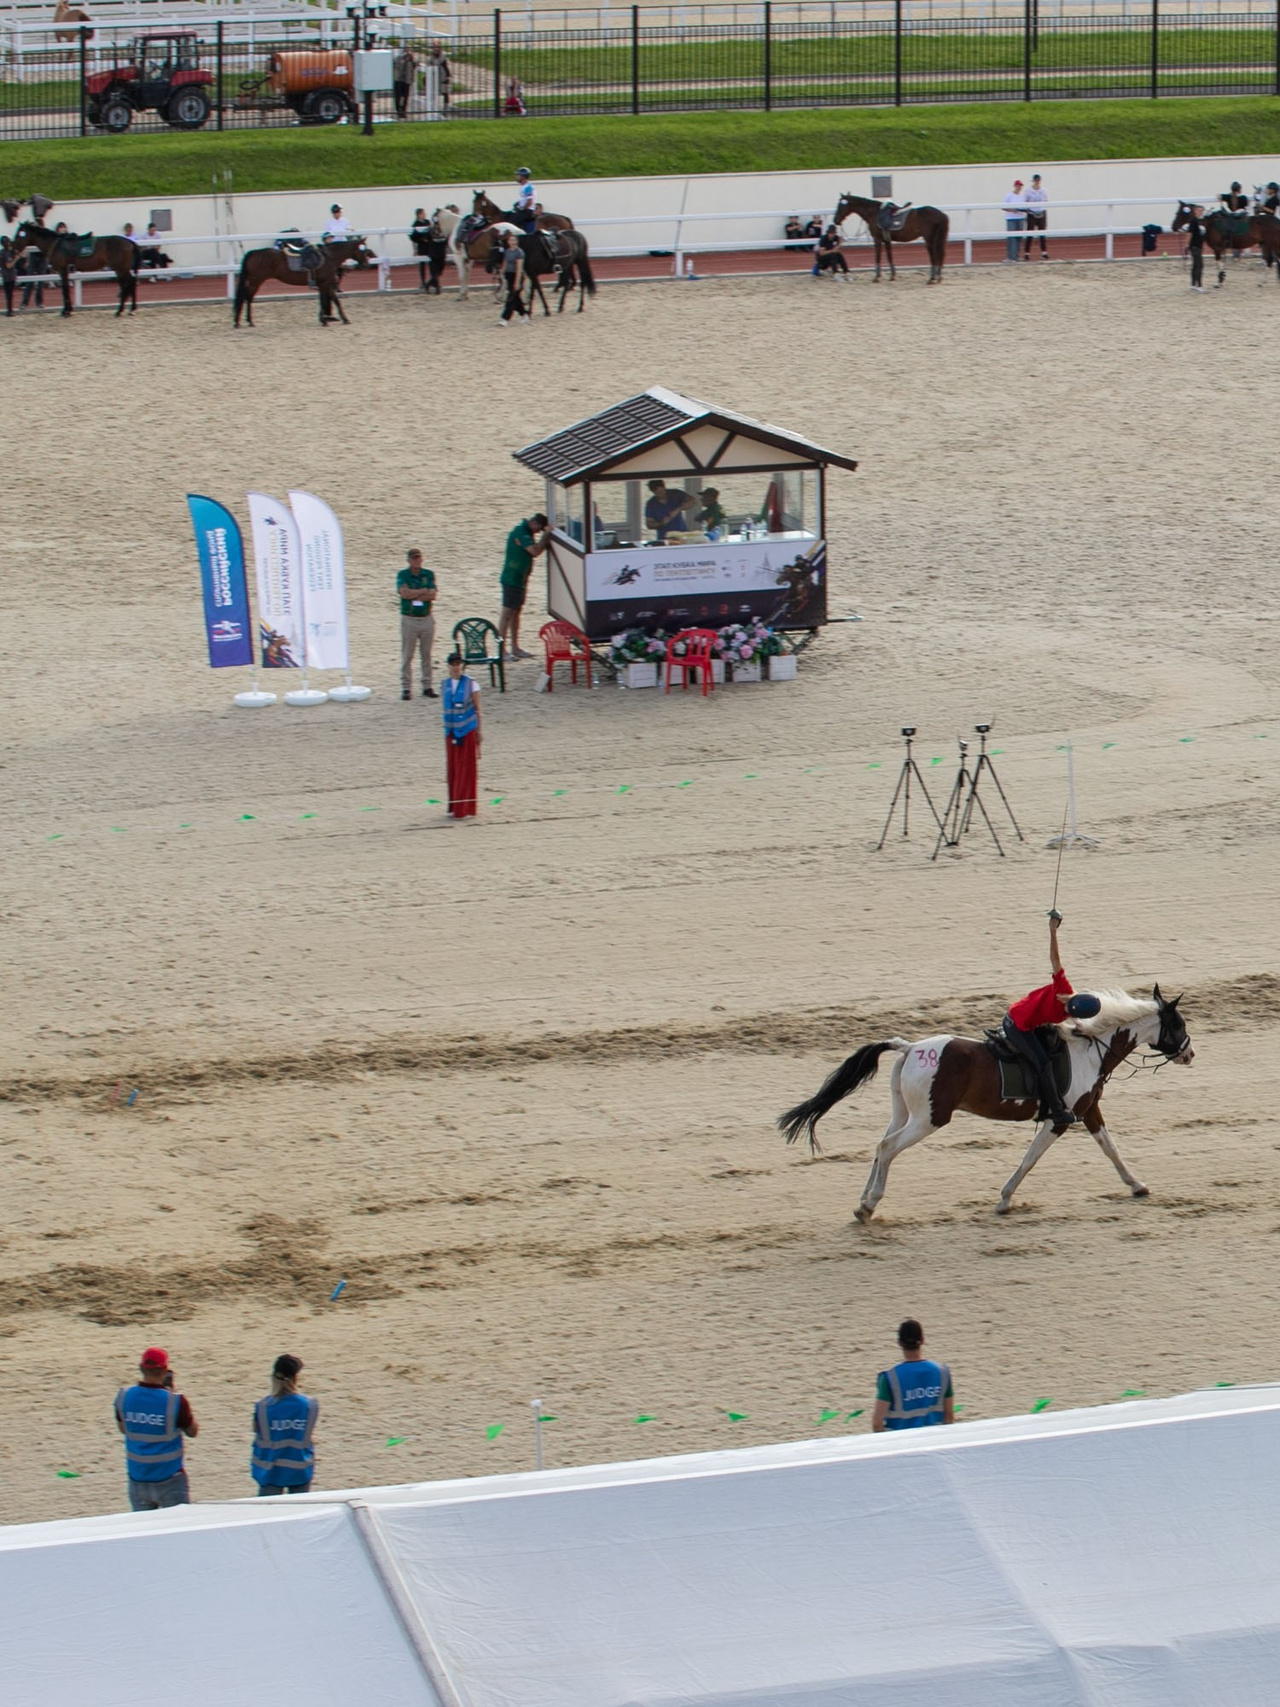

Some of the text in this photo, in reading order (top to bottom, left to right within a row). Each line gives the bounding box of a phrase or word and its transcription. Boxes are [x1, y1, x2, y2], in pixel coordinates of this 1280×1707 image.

[914, 1048, 939, 1068] 38
[903, 1386, 942, 1401] JUDGE
[124, 1411, 165, 1426] JUDGE
[270, 1419, 307, 1431] JUDGE
